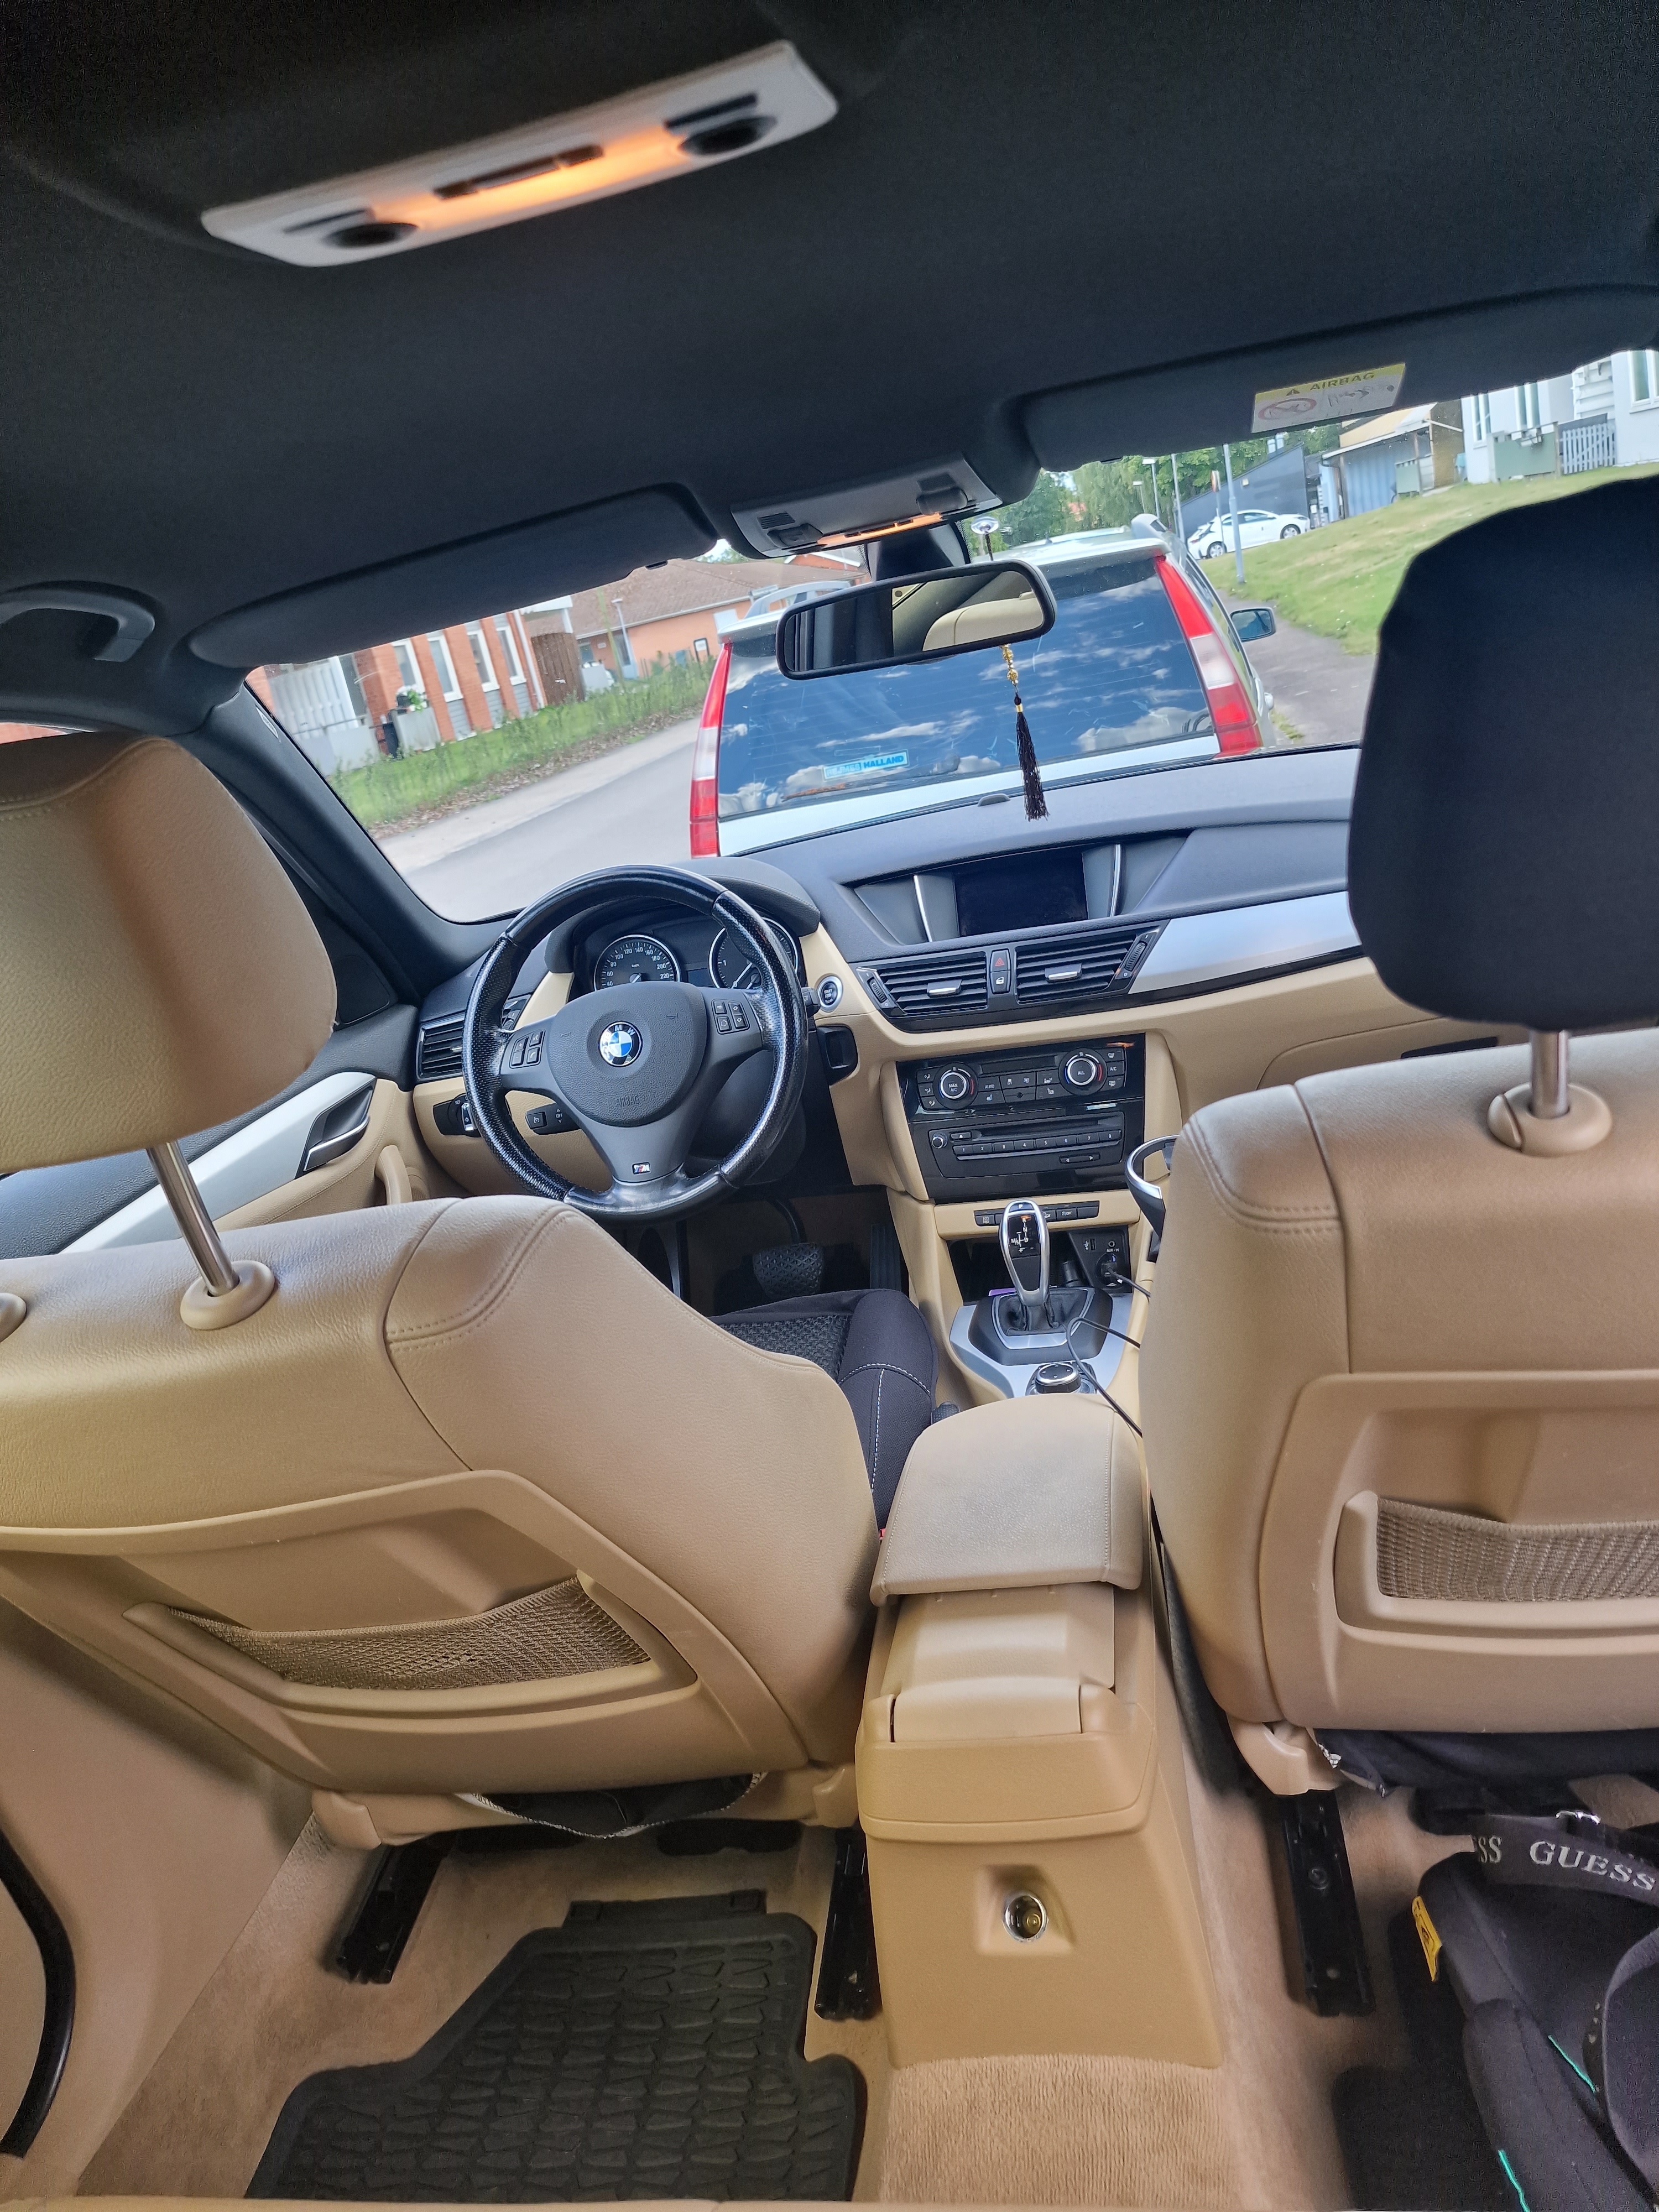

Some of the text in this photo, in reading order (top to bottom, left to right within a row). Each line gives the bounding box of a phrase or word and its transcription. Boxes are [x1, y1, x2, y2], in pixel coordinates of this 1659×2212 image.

[1310, 373, 1375, 390] AIRBAG
[864, 755, 904, 768] HALLAND
[617, 1095, 640, 1108] AIRBAG
[1530, 1840, 1656, 1891] GUESS
